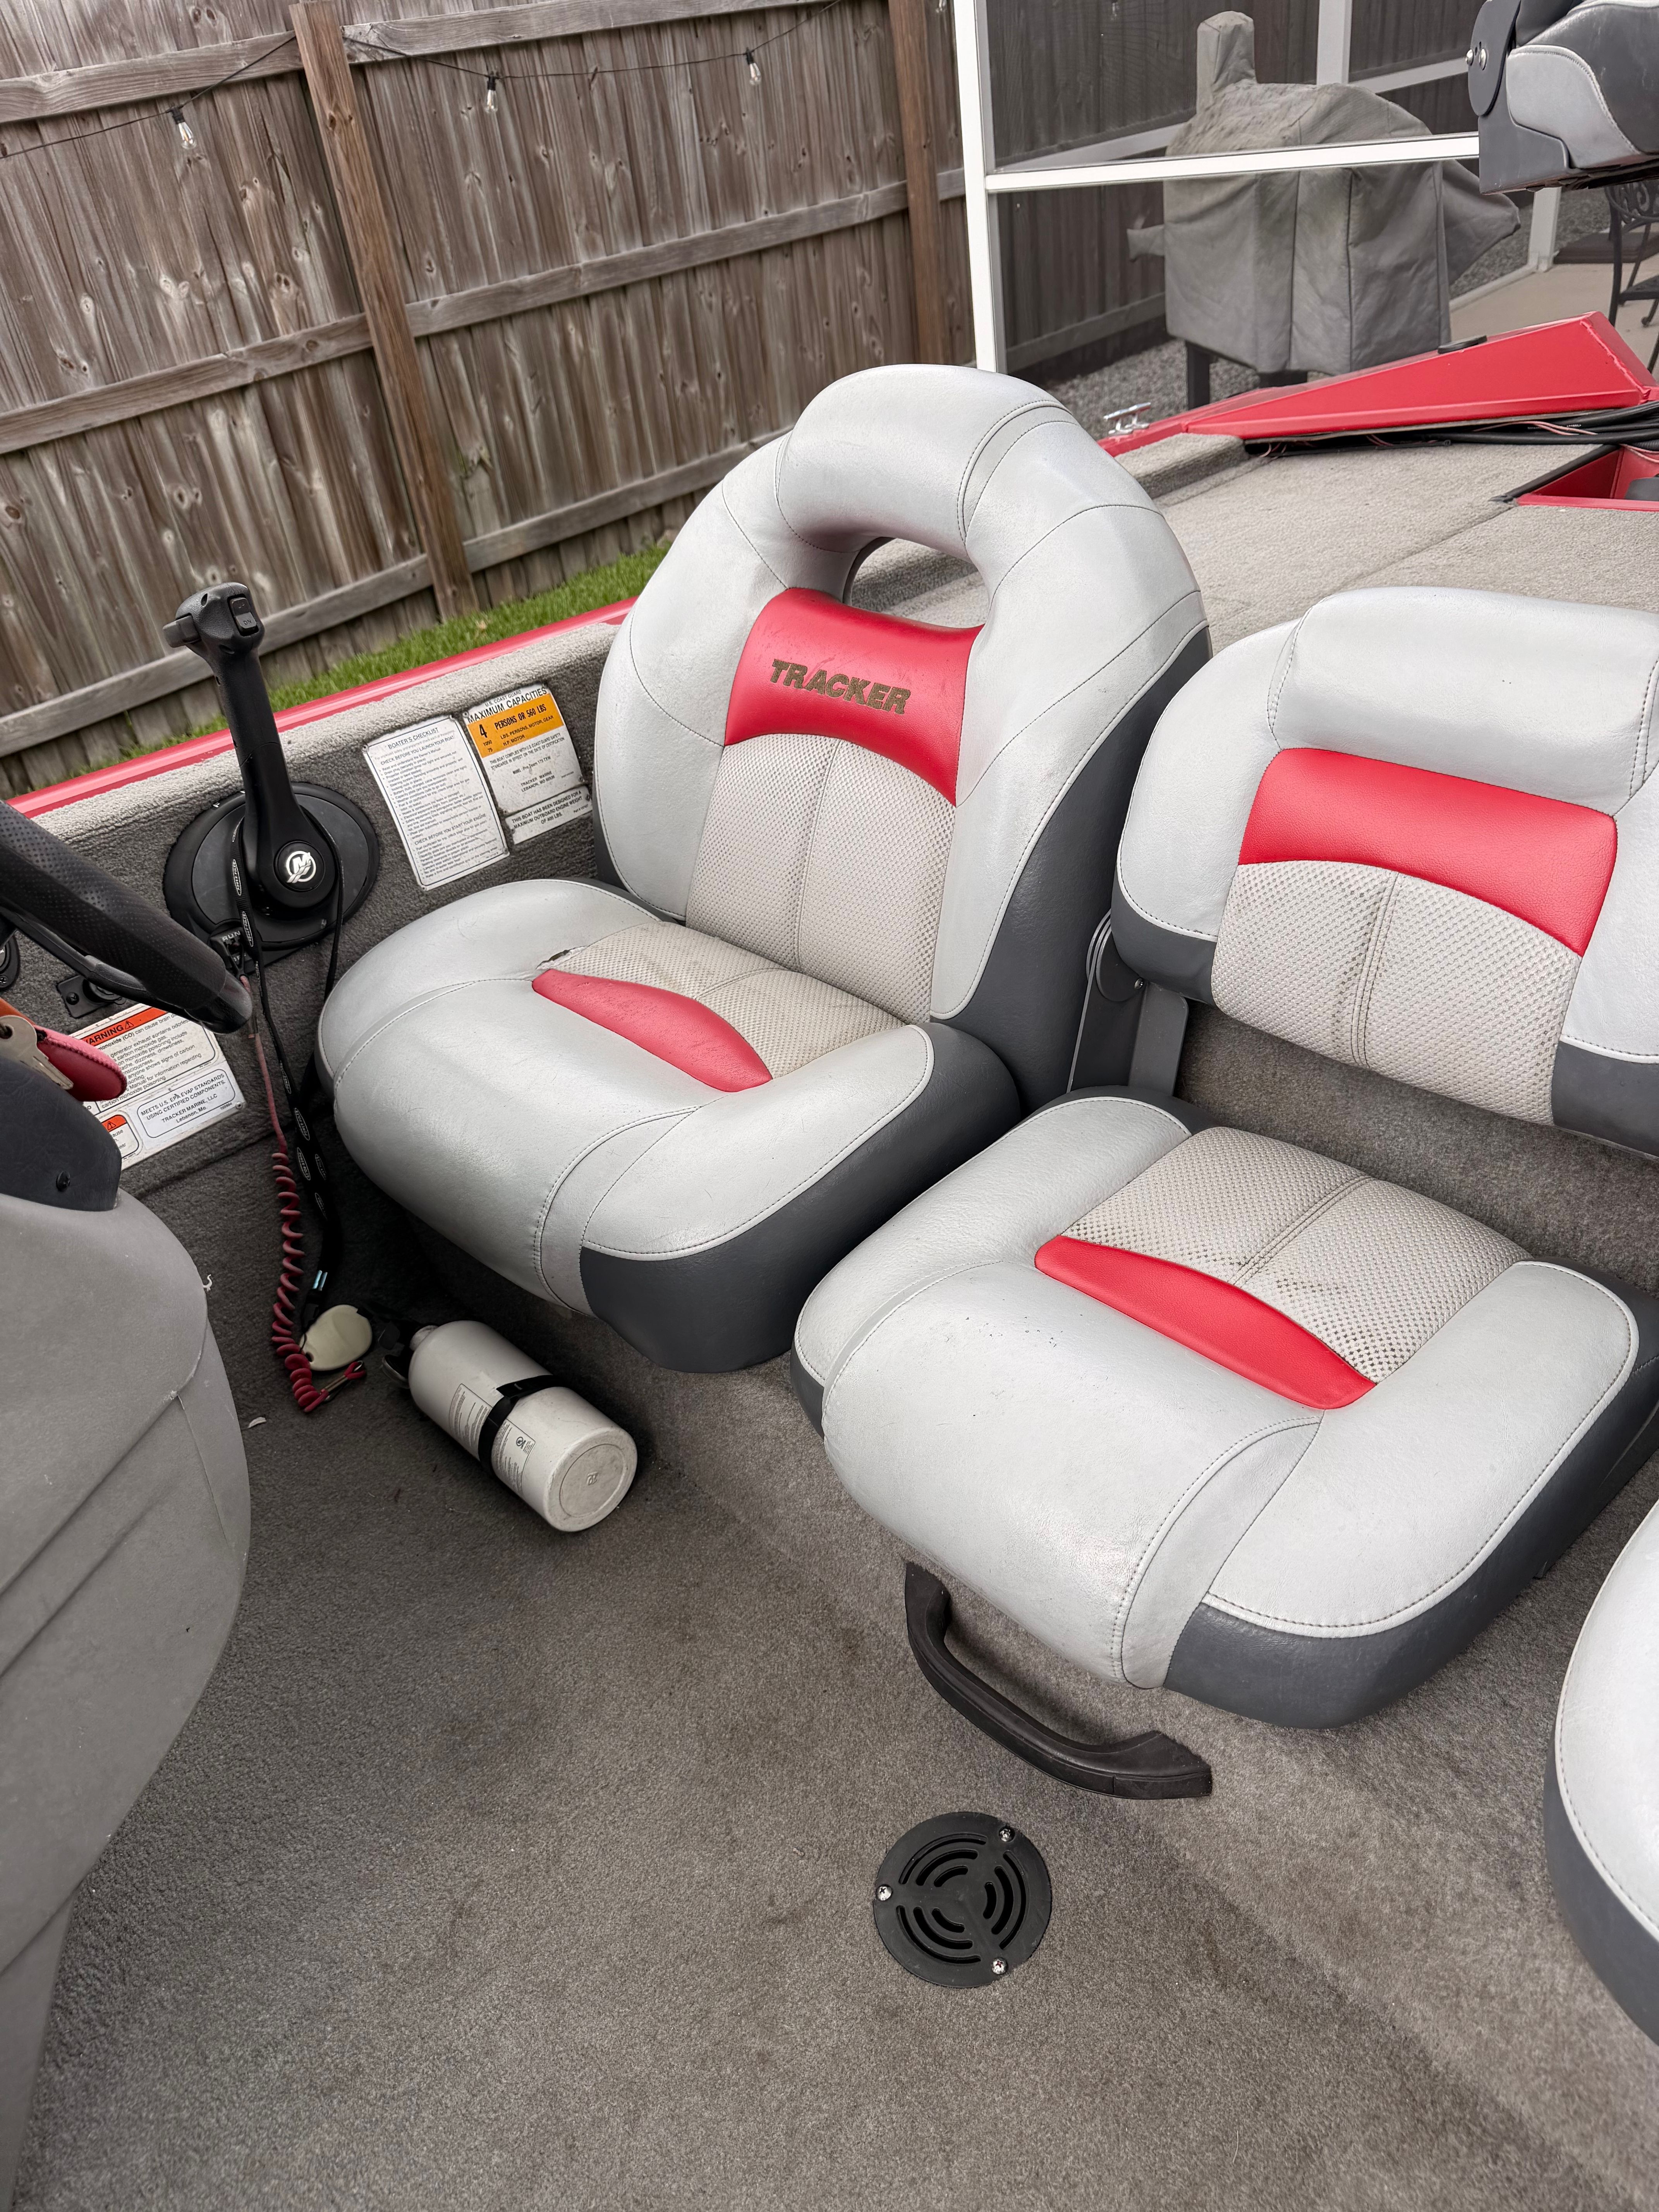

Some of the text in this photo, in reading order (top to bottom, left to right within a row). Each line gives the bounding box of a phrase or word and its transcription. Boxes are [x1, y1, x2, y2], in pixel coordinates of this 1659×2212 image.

[493, 695, 507, 704] COAST
[507, 689, 522, 698] GUARD
[770, 659, 911, 715] TRACKER
[467, 686, 547, 724] MAXIMUM CAPACITIES
[477, 703, 547, 739] 4 PERSONS OR 560 LBS
[388, 737, 413, 749] BOATER'S
[412, 727, 439, 740] CHECKLIST
[510, 734, 525, 743] MOTOR
[380, 757, 395, 765] CHECK
[395, 751, 411, 760] BEFORE
[419, 742, 435, 751] LAUNCH
[520, 777, 538, 787] TRACKER
[514, 817, 534, 830] MAXIMUM
[533, 808, 556, 821] OUTBOARD
[568, 796, 583, 805] WEIGHT
[521, 811, 533, 819] BOAT
[541, 802, 553, 811] BEEN
[552, 794, 571, 806] DESIGNED
[428, 831, 443, 840] BEFORE
[222, 931, 241, 942] RUN
[110, 1017, 190, 1058] generator exhaust contains odorles
[122, 1031, 135, 1041] (CO)
[144, 1021, 158, 1030] cause
[158, 1015, 171, 1024] brain
[117, 1049, 134, 1061] carbon
[134, 1039, 157, 1053] monoxide
[124, 1030, 187, 1062] monoxide poisoning include
[127, 1068, 146, 1080] anyone
[145, 1060, 161, 1070] shows
[160, 1054, 174, 1064] signs
[179, 1043, 196, 1054] carbon
[129, 1078, 147, 1089] Manual
[154, 1063, 180, 1078] information
[179, 1052, 202, 1066] regarding
[101, 1097, 119, 1109] carbon
[119, 1086, 143, 1100] monoxide
[143, 1075, 166, 1089] poisoning
[141, 1073, 225, 1116] MEETS U.S. EPA EVAP STANDARDS
[146, 1109, 163, 1120] USING
[162, 1096, 190, 1112] CERTIFIED
[161, 1093, 218, 1123] TRACKER MARINE, LLC
[176, 1109, 199, 1123] Lebanon,
[112, 1129, 124, 1137] ause
